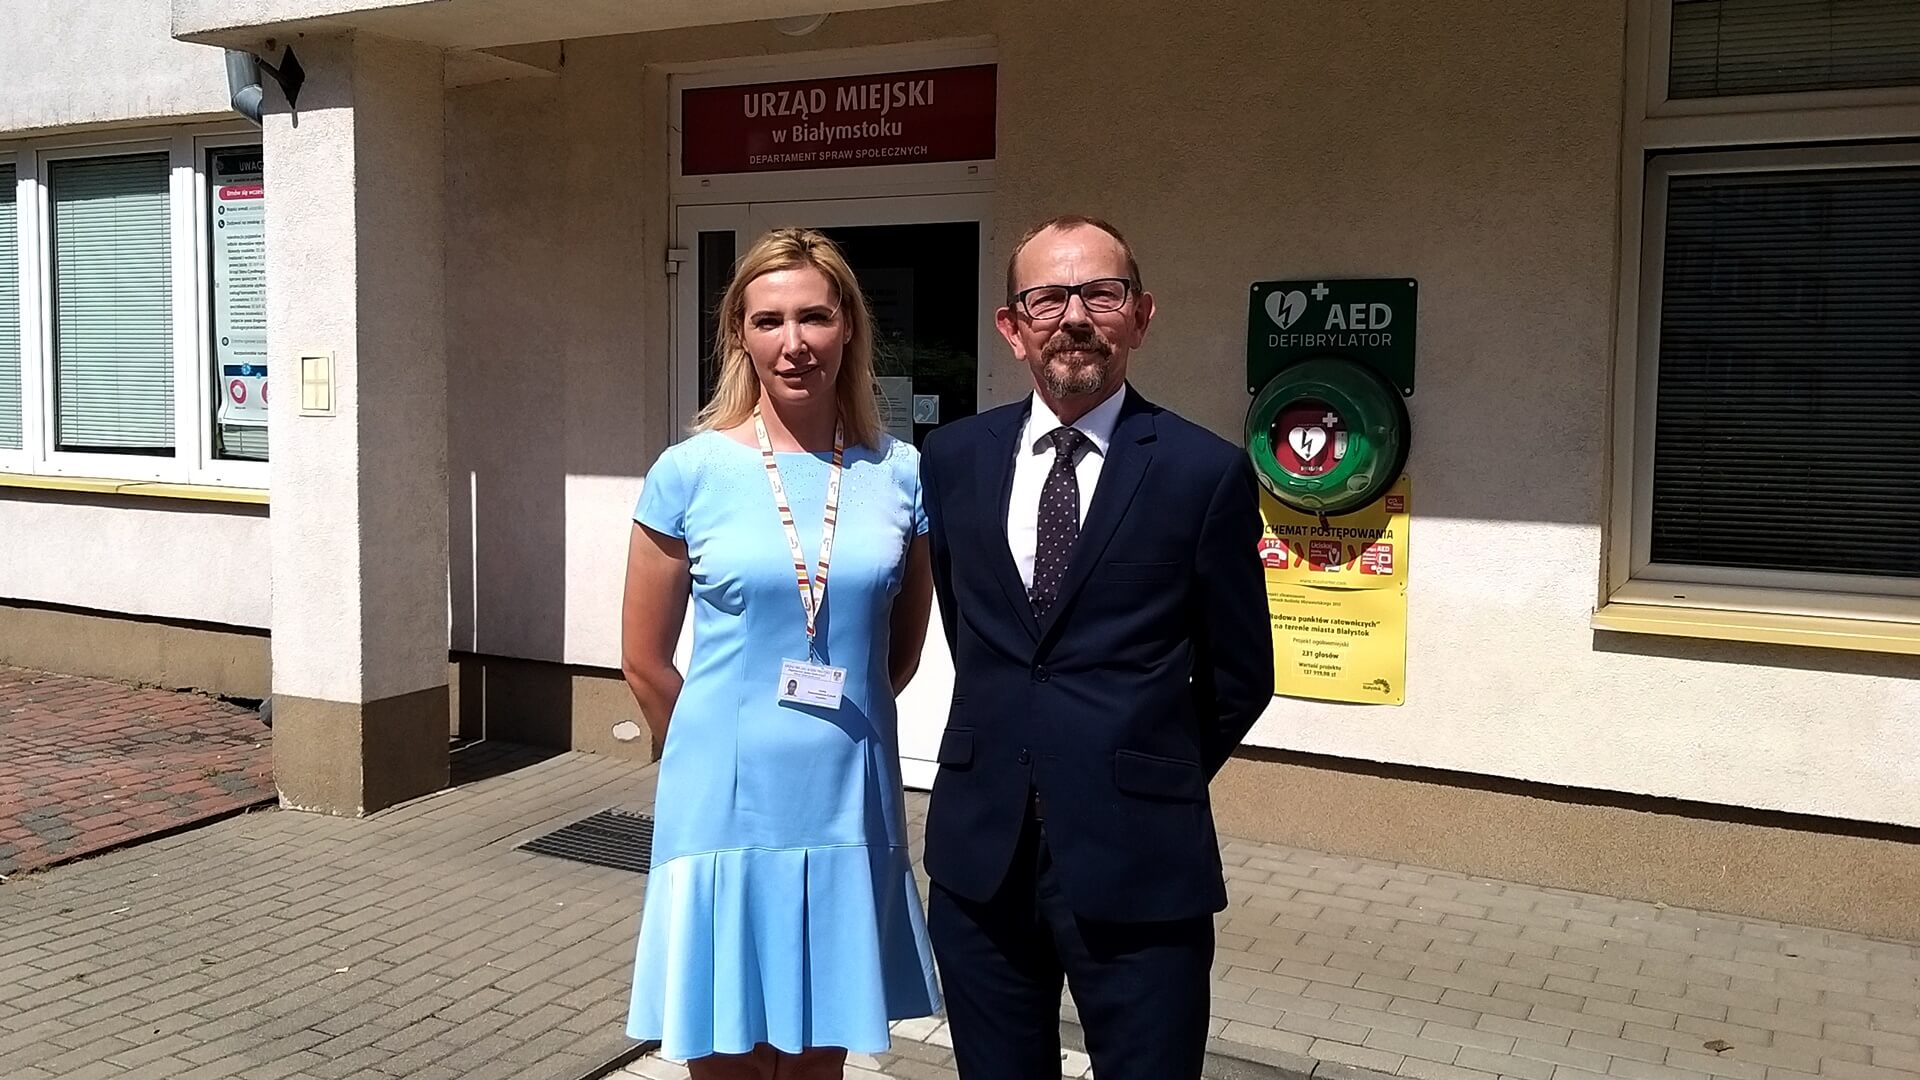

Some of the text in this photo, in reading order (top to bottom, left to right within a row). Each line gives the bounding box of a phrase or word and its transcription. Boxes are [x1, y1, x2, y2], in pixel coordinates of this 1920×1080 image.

[743, 79, 934, 120] URZĄD MIEJSKI
[772, 117, 902, 144] w Białymstoku
[749, 145, 928, 165] DEPARTAMENT SPRAW SPOŁECZNYCH
[240, 161, 263, 171] UWAG
[1324, 303, 1393, 331] AED
[1269, 333, 1392, 348] DEFIBRYLATOR
[1265, 524, 1394, 541] CHEMAT POSTĘPOWANIA
[1264, 540, 1281, 548] 112
[1298, 615, 1329, 624] punktów
[1311, 625, 1335, 634] miasta
[1336, 627, 1370, 637] Białystok
